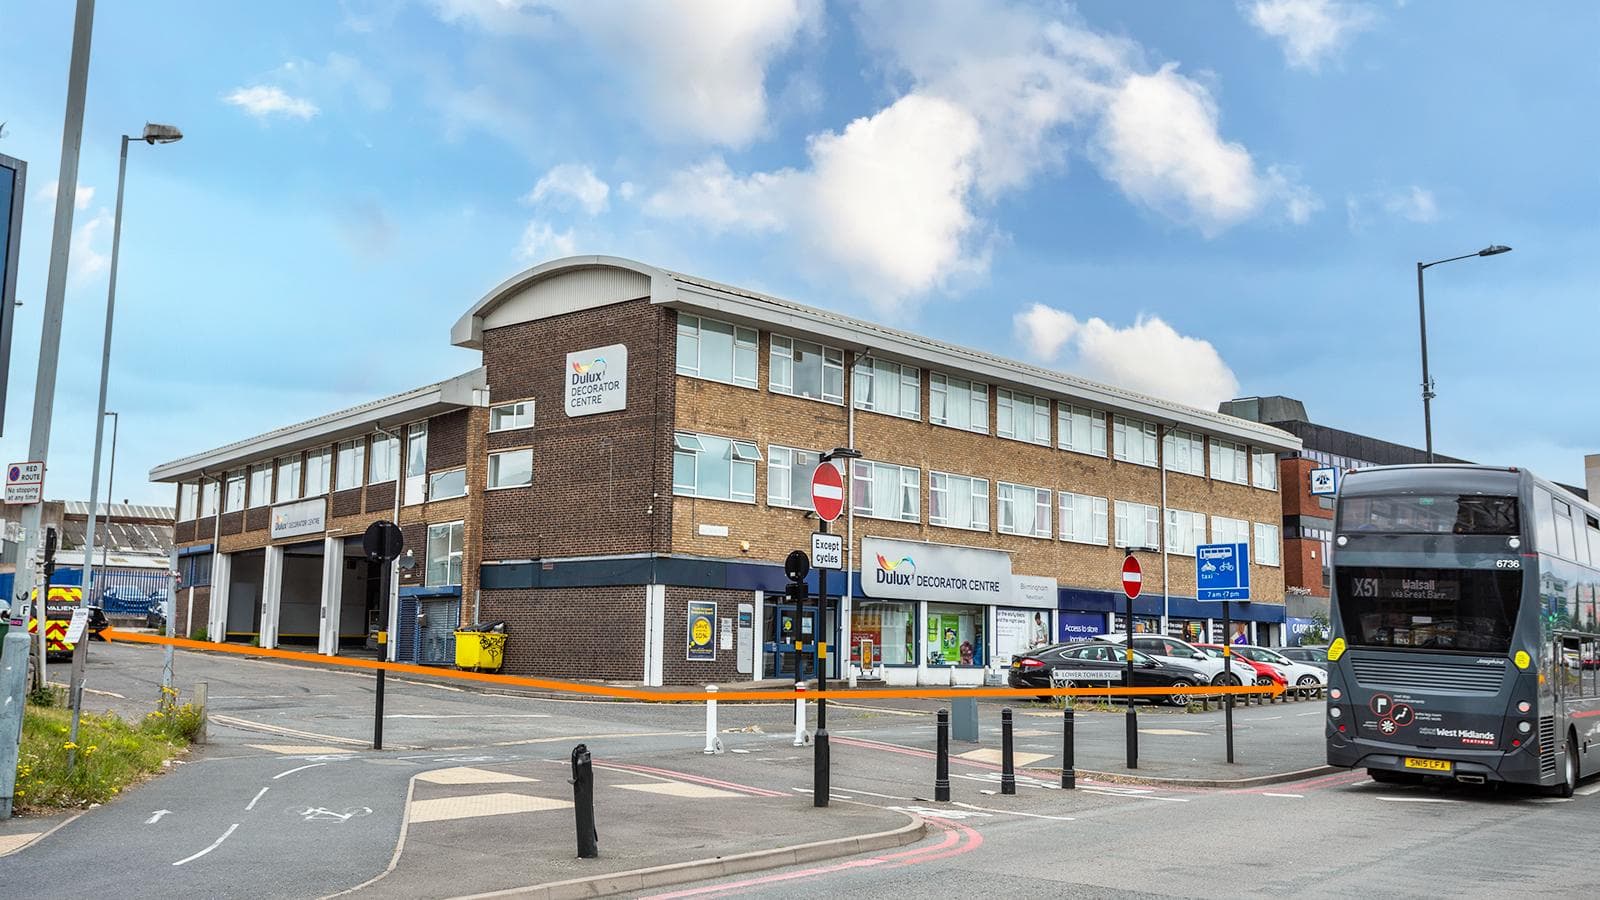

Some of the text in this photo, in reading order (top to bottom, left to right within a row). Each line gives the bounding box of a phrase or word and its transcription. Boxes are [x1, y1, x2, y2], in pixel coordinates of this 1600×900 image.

[572, 372, 602, 385] Dulux
[571, 381, 620, 397] DECORATOR
[571, 394, 602, 408] CENTRE
[816, 539, 839, 551] Except
[816, 553, 838, 564] cycles
[1496, 560, 1520, 568] 6736
[876, 568, 1000, 592] Dulux DECORATOR CENTRE
[1353, 578, 1435, 597] X51 Walsall
[1405, 590, 1427, 599] Great
[1065, 624, 1082, 633] Access
[1082, 625, 1088, 633] to
[1436, 728, 1495, 740] West Midlands
[1410, 758, 1446, 769] SN15 LFA
